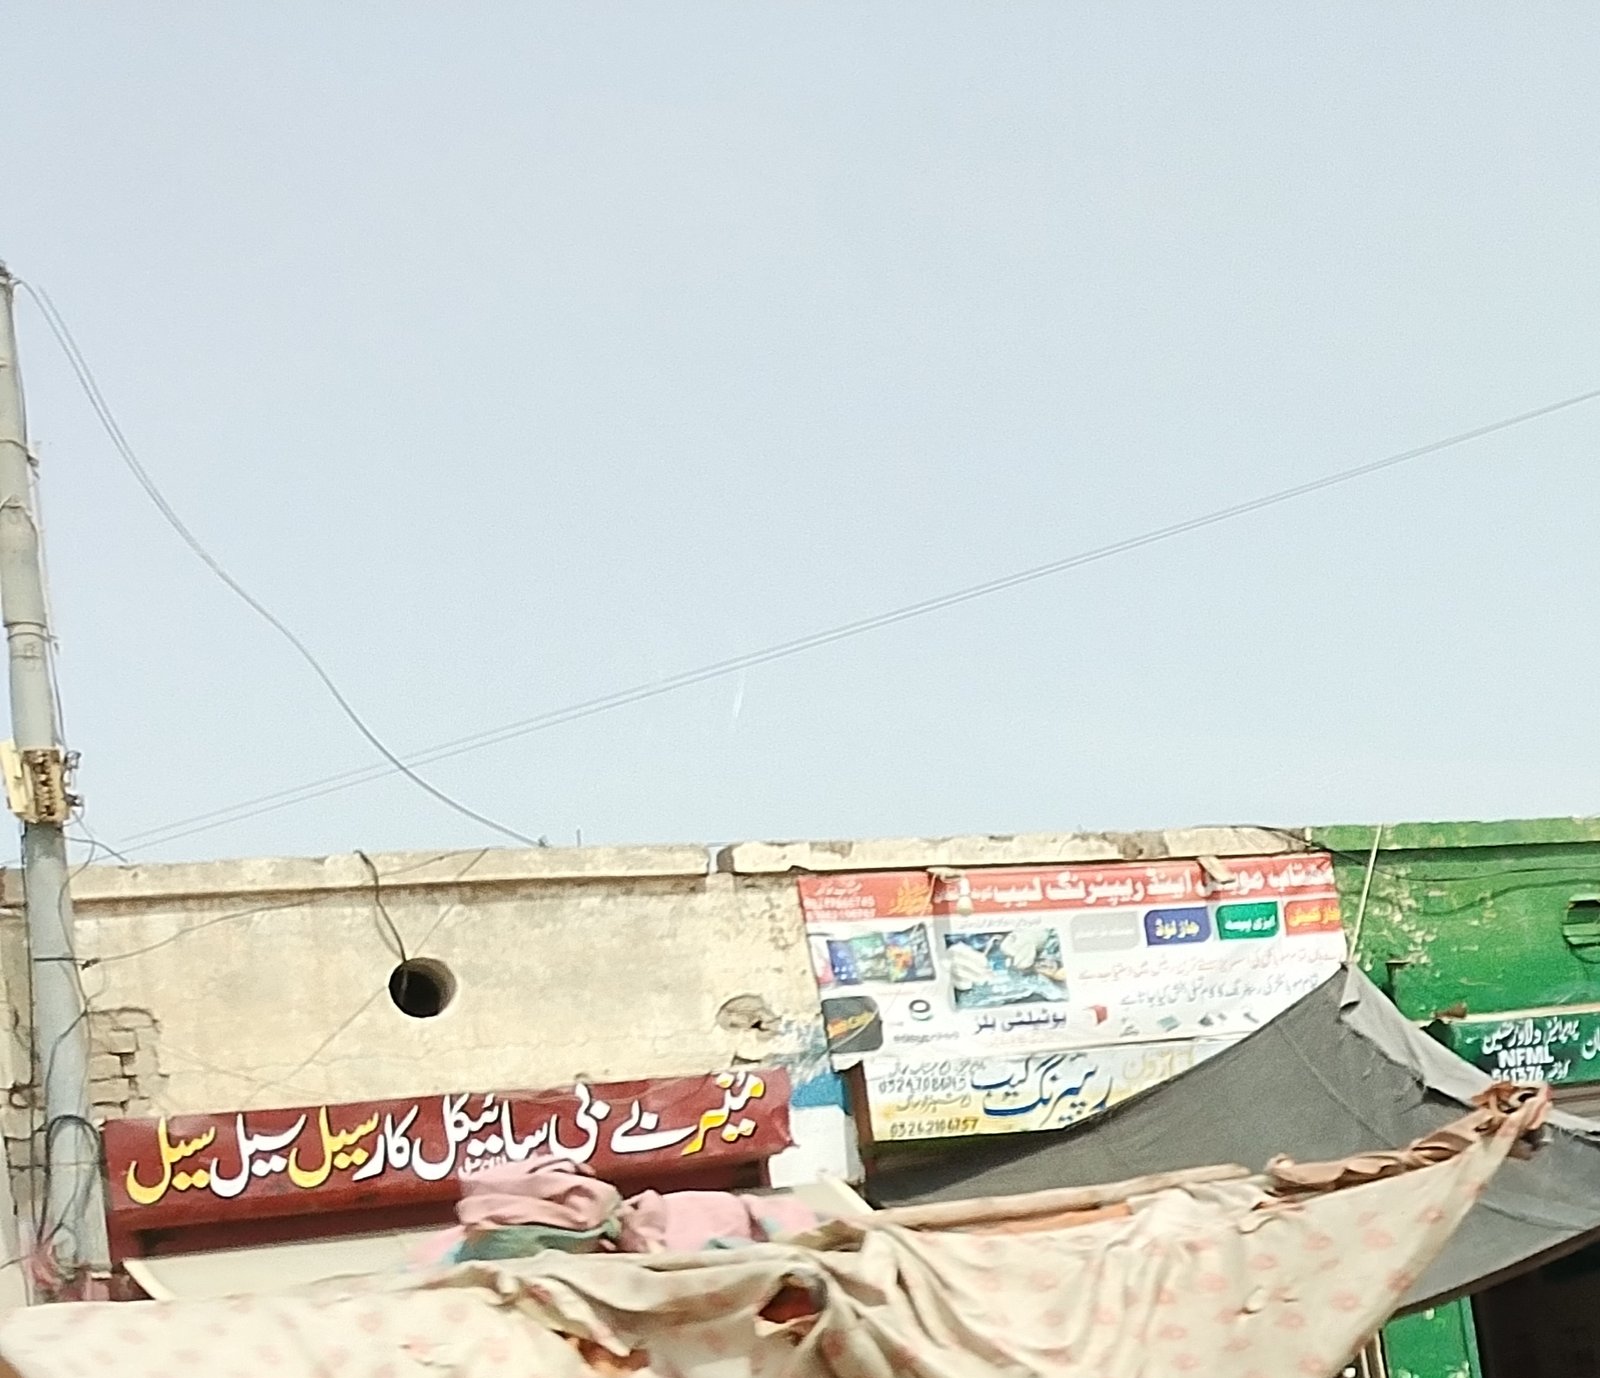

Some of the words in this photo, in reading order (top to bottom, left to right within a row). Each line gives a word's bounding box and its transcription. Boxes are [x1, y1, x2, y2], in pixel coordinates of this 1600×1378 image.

[126, 1115, 216, 1205] سیل
[210, 1112, 307, 1198] سیل
[287, 1104, 380, 1189] سیل
[352, 1104, 420, 1182] کار
